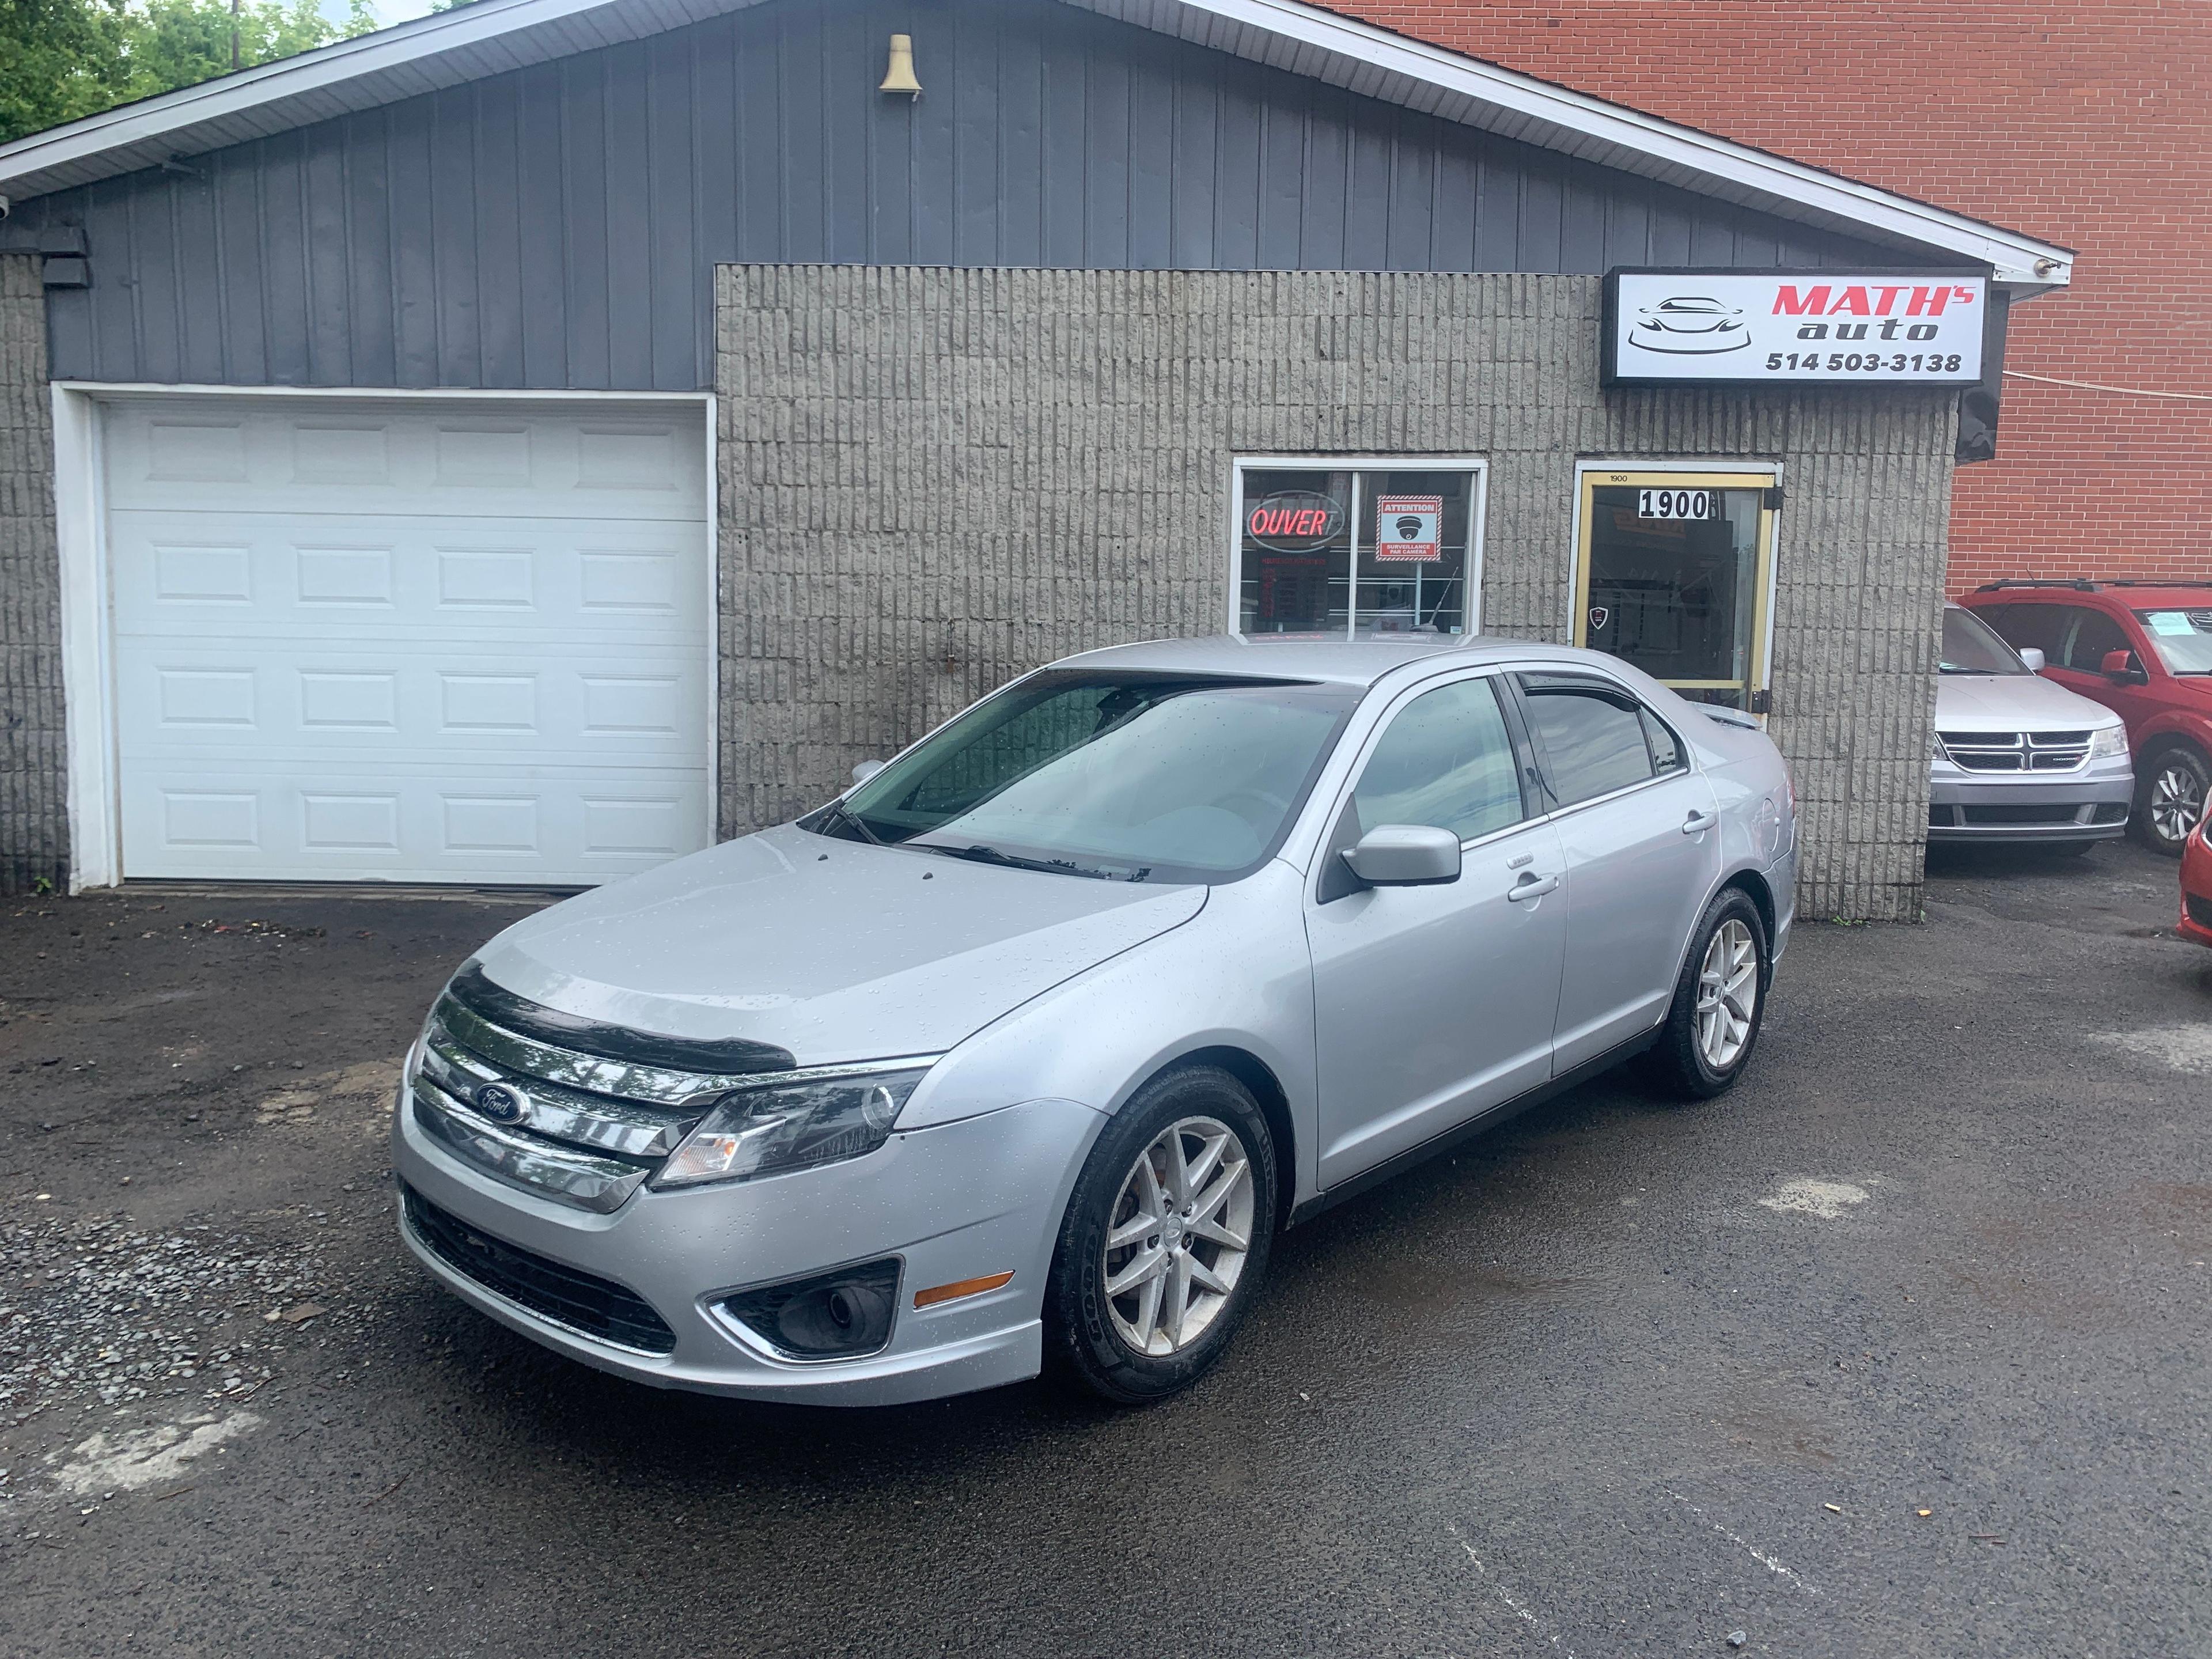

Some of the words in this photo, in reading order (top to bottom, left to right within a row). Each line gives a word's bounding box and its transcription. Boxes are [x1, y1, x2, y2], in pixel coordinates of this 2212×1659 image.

[1796, 319, 1938, 340] auto
[1766, 353, 1819, 370] 514
[1826, 354, 1961, 372] 503-3138
[1641, 491, 1707, 518] 1900
[483, 1089, 511, 1115] Ford
